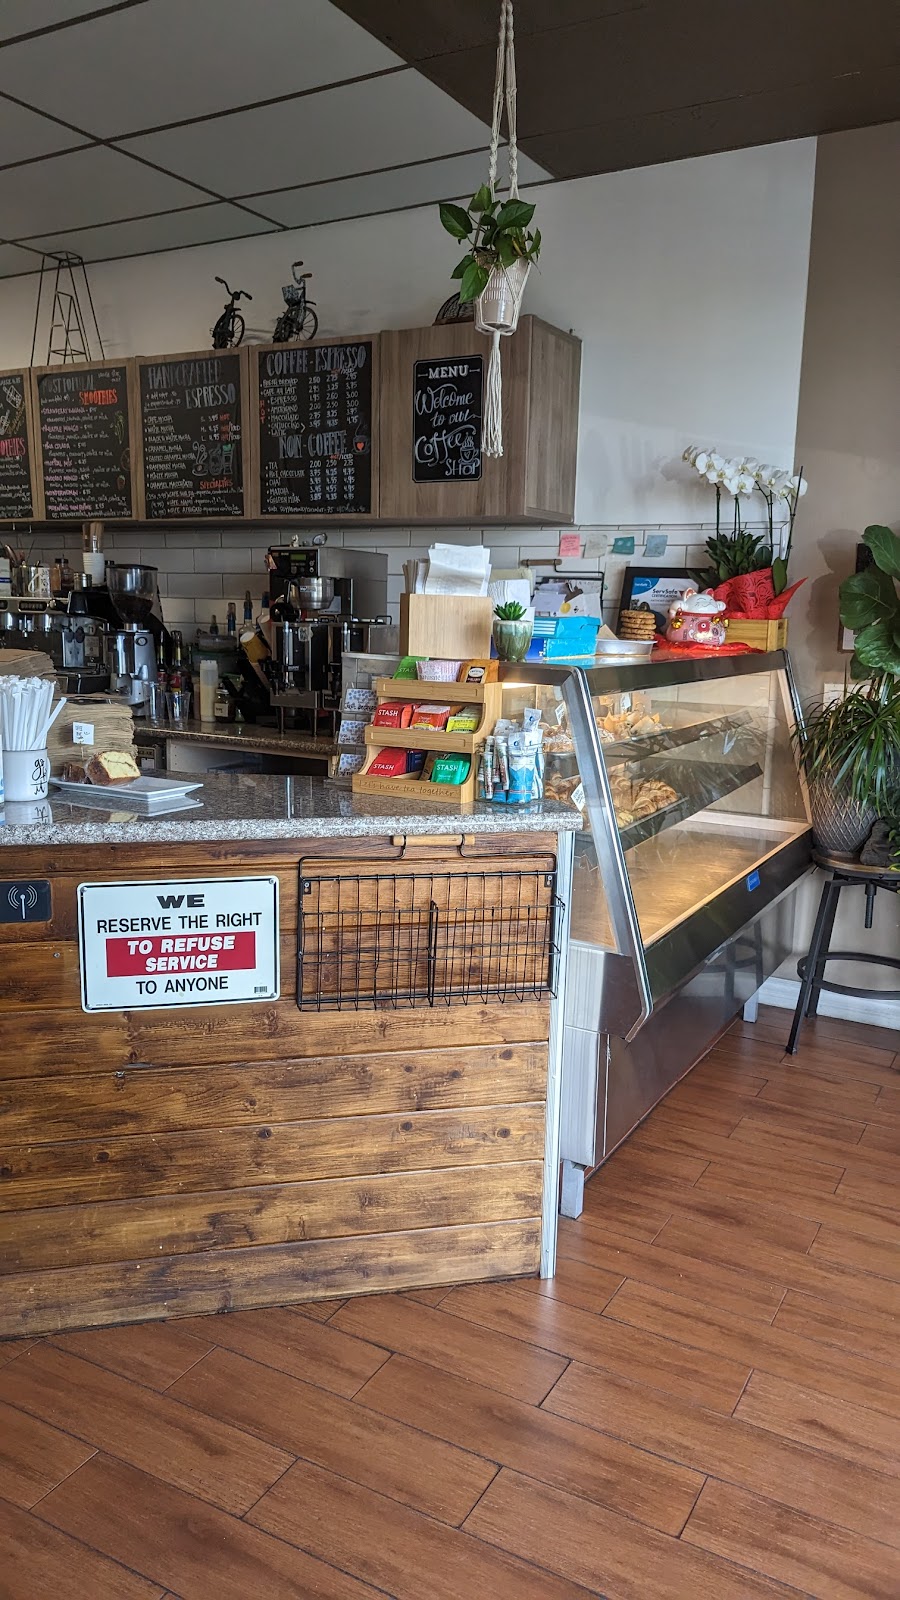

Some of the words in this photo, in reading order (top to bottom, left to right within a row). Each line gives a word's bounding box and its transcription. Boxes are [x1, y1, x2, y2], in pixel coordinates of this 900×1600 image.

[266, 350, 309, 378] COFFEE
[314, 345, 366, 373] ESPRESSO
[428, 365, 469, 379] MENU
[79, 388, 118, 406] SMOOTHIES
[185, 382, 236, 409] ESPRESSO
[270, 395, 298, 404] ESPRESSO
[346, 391, 359, 399] 3.00
[415, 383, 475, 415] Welcome
[430, 411, 446, 427] to
[449, 409, 481, 424] our
[415, 425, 476, 467] Coffee
[268, 461, 278, 470] TEA
[309, 459, 322, 468] 2.00
[342, 467, 355, 476] 4.75
[445, 458, 480, 476] SHOP
[377, 709, 398, 717] STASH
[373, 763, 394, 771] STASH
[436, 764, 459, 772] STASH
[379, 782, 400, 792] have
[402, 784, 416, 794] tea
[419, 785, 456, 798] together
[156, 893, 205, 910] WE
[97, 916, 172, 934] RESERVE
[178, 914, 209, 930] THE
[216, 912, 263, 928] RIGHT
[127, 940, 154, 955] TO
[161, 935, 236, 953] REFUSE
[145, 953, 219, 973] SERVICE
[135, 980, 158, 995] TO
[164, 976, 229, 993] ANYONE
